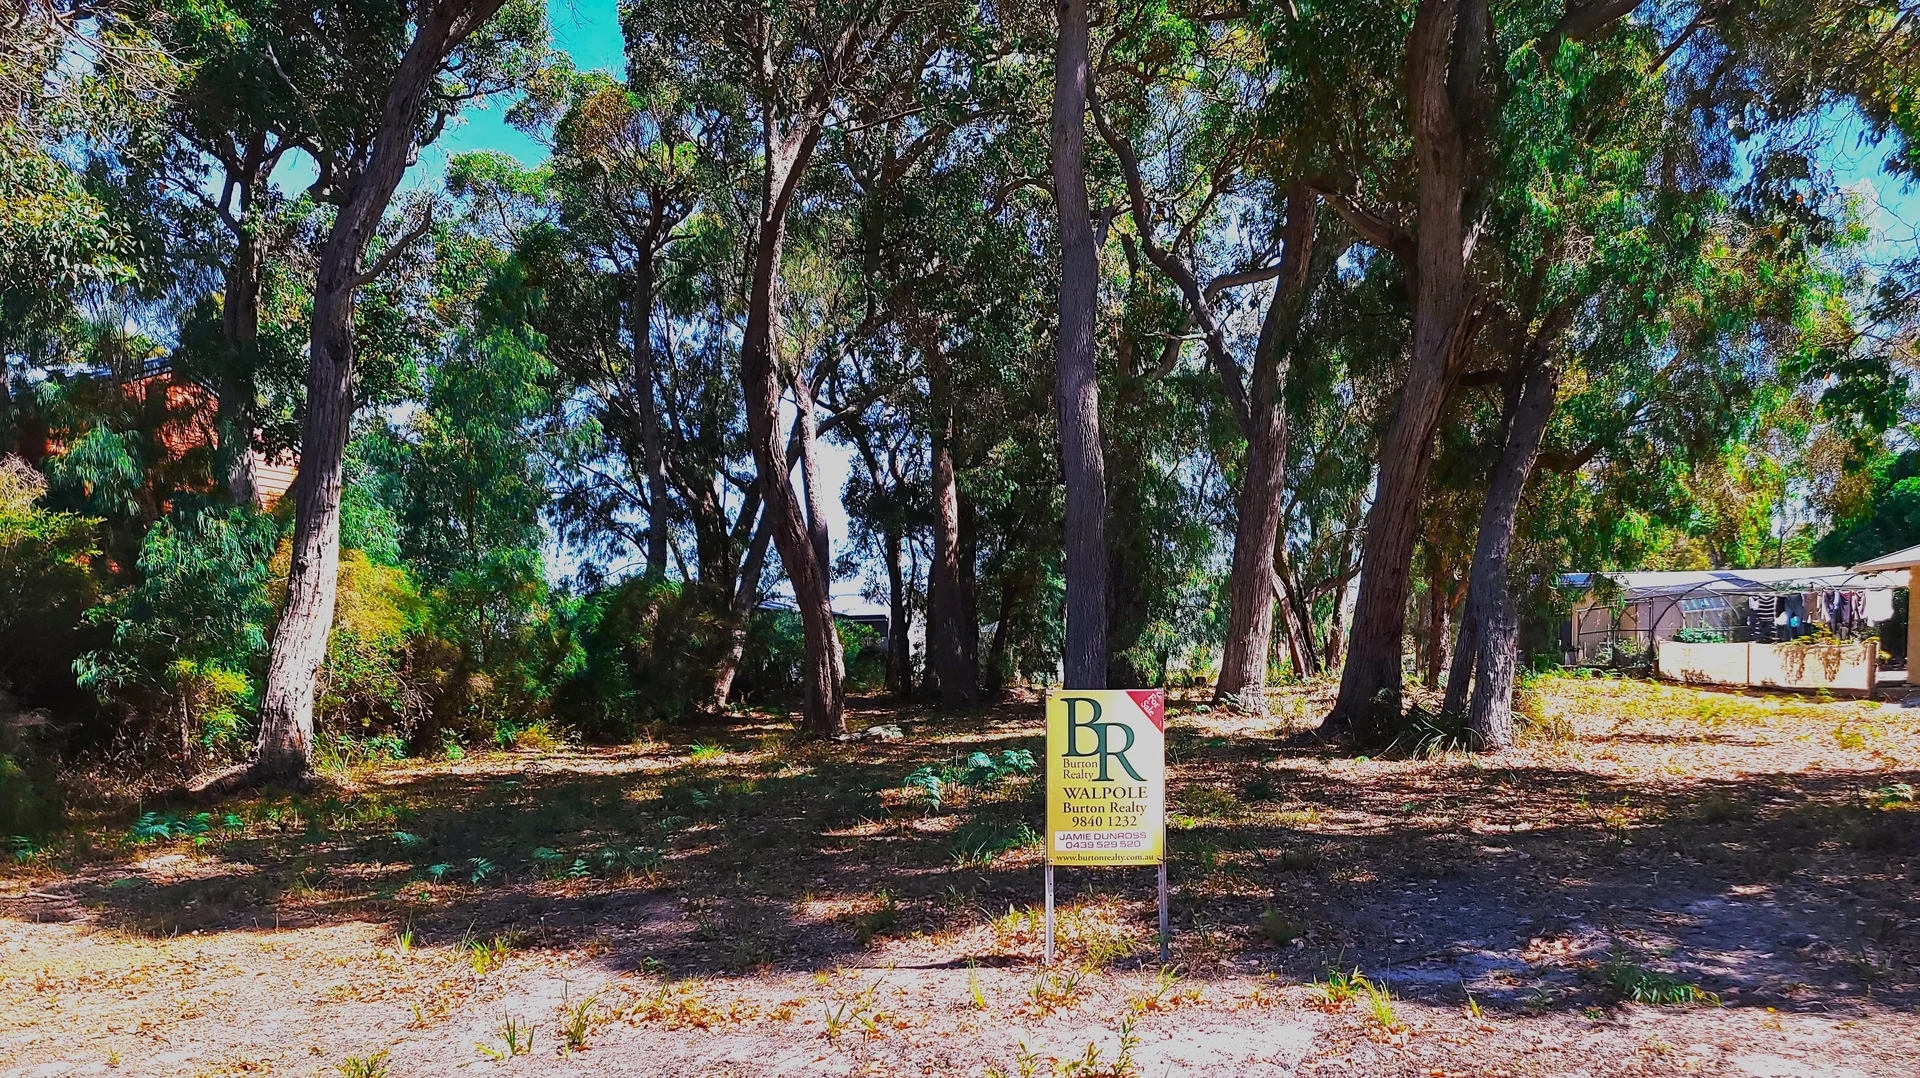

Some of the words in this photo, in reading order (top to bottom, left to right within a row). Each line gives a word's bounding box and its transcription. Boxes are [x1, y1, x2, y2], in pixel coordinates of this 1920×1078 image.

[1147, 692, 1161, 709] For
[1140, 699, 1155, 717] Sale
[1063, 758, 1098, 769] Burton
[1063, 769, 1094, 782] Realty
[1063, 786, 1148, 800] WALPOLE
[1063, 802, 1105, 814] Burton
[1110, 801, 1147, 816] Realty
[1072, 815, 1103, 828] 9840
[1108, 815, 1137, 828] 1232
[1059, 833, 1091, 841] JAMIE
[1094, 832, 1147, 840] DUNROSS
[1065, 841, 1094, 849] 0439
[1096, 841, 1118, 849] 529
[1120, 840, 1141, 848] 520
[1056, 853, 1154, 863] www.burtonrealty.com.au
